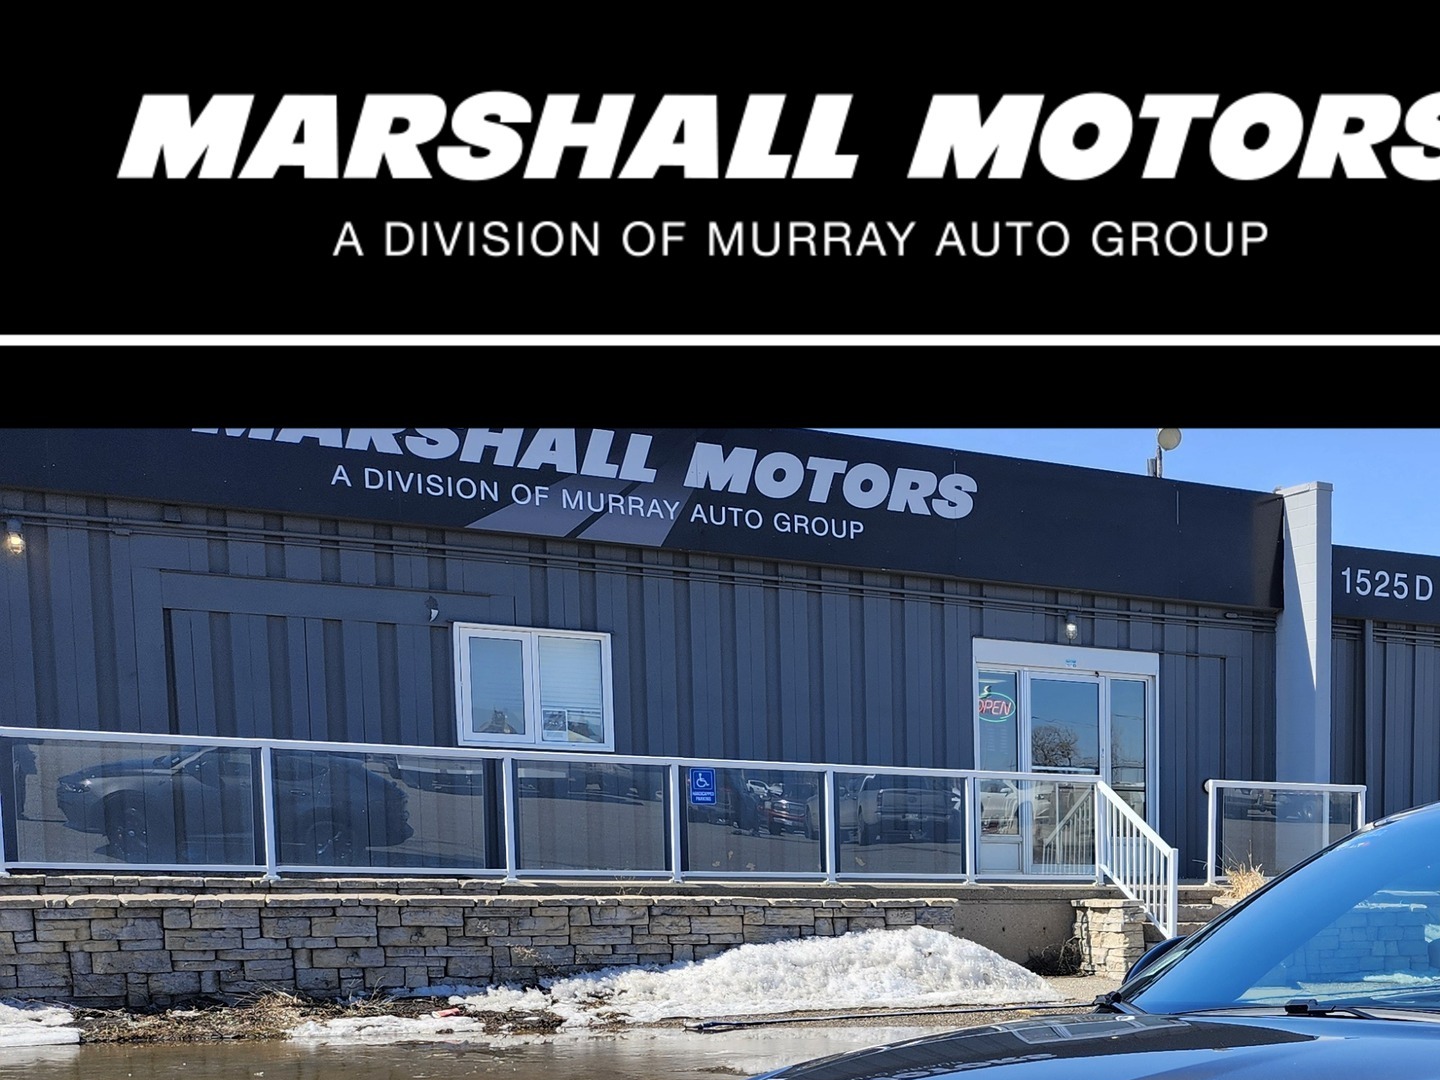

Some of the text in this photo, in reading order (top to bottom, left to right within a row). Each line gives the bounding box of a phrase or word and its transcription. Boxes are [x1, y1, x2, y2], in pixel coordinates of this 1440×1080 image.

[331, 464, 865, 541] A DIVISION OF MURRAY AUTO GROUP
[683, 441, 978, 520] MOTORS
